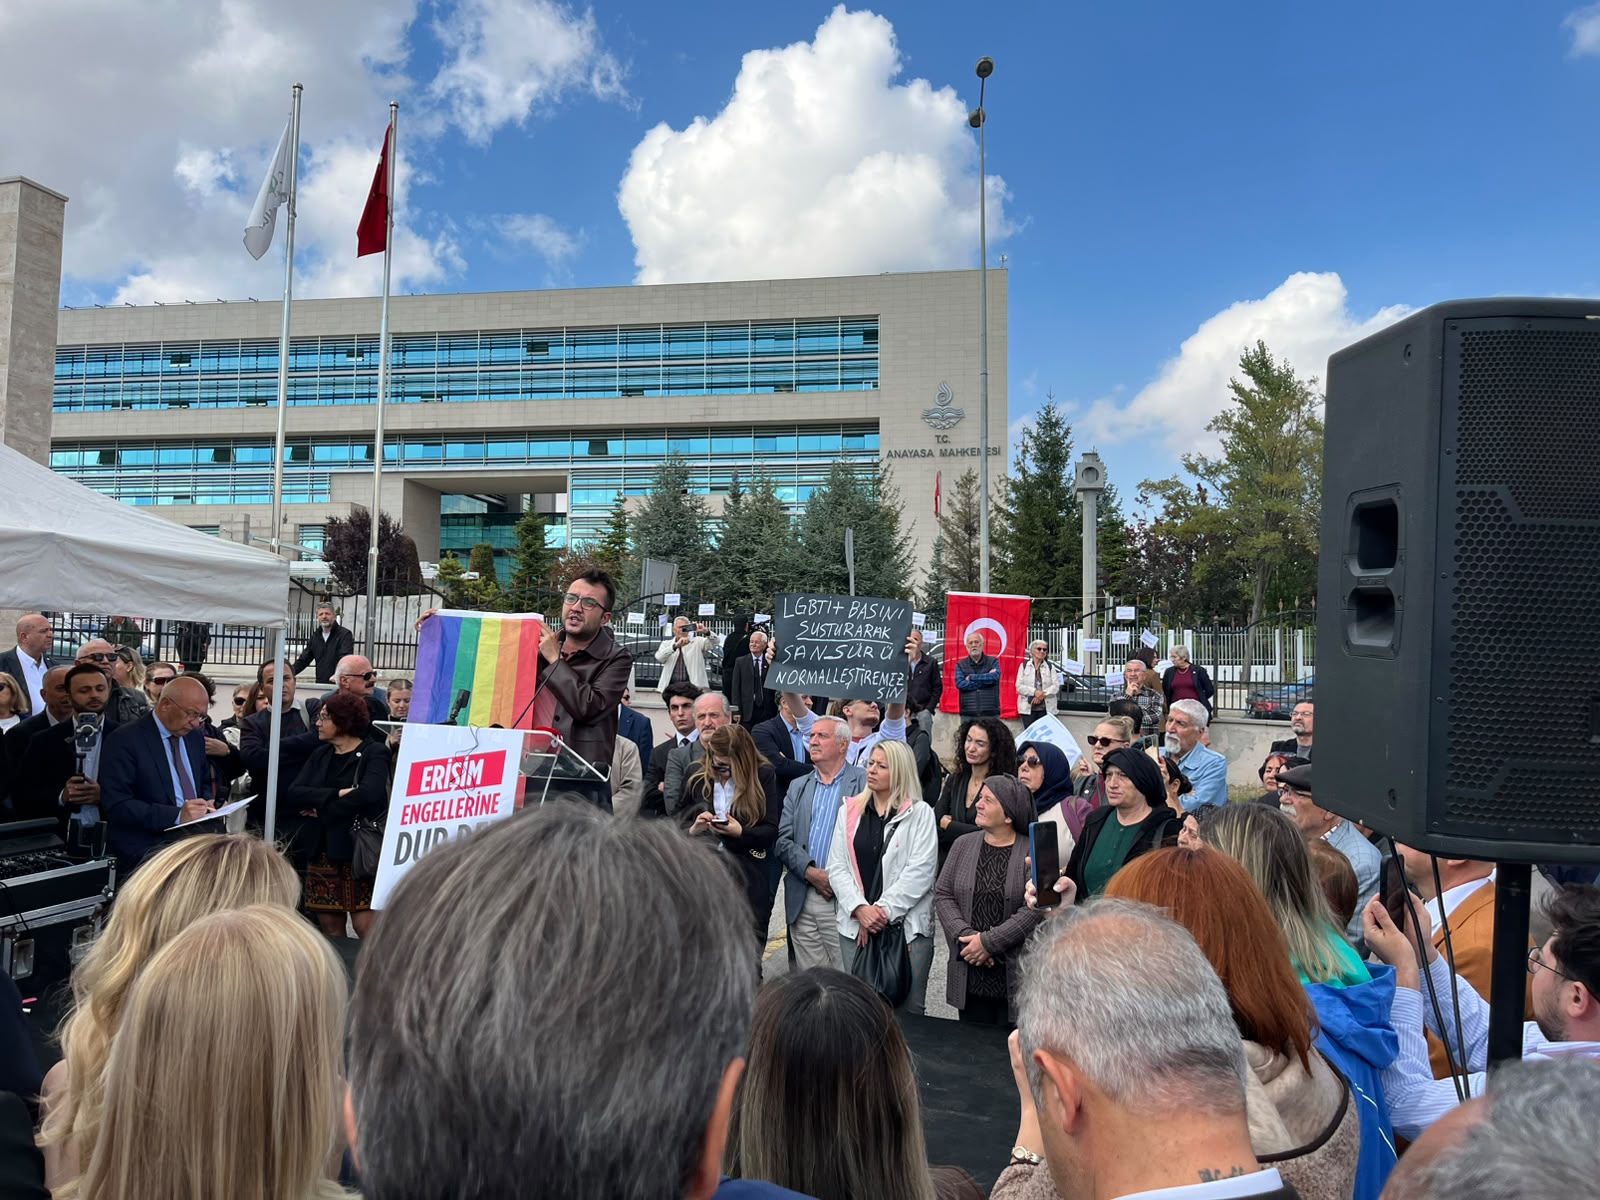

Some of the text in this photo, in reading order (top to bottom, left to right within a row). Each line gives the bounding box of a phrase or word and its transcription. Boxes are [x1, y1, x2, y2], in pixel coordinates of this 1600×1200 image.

[886, 448, 935, 459] ANAYASA
[848, 600, 905, 622] BASINI
[795, 620, 891, 639] SUSTURARAK
[775, 664, 905, 690] NORMALLEŞTİREMEZ
[400, 791, 501, 826] ENGELLERİNE
